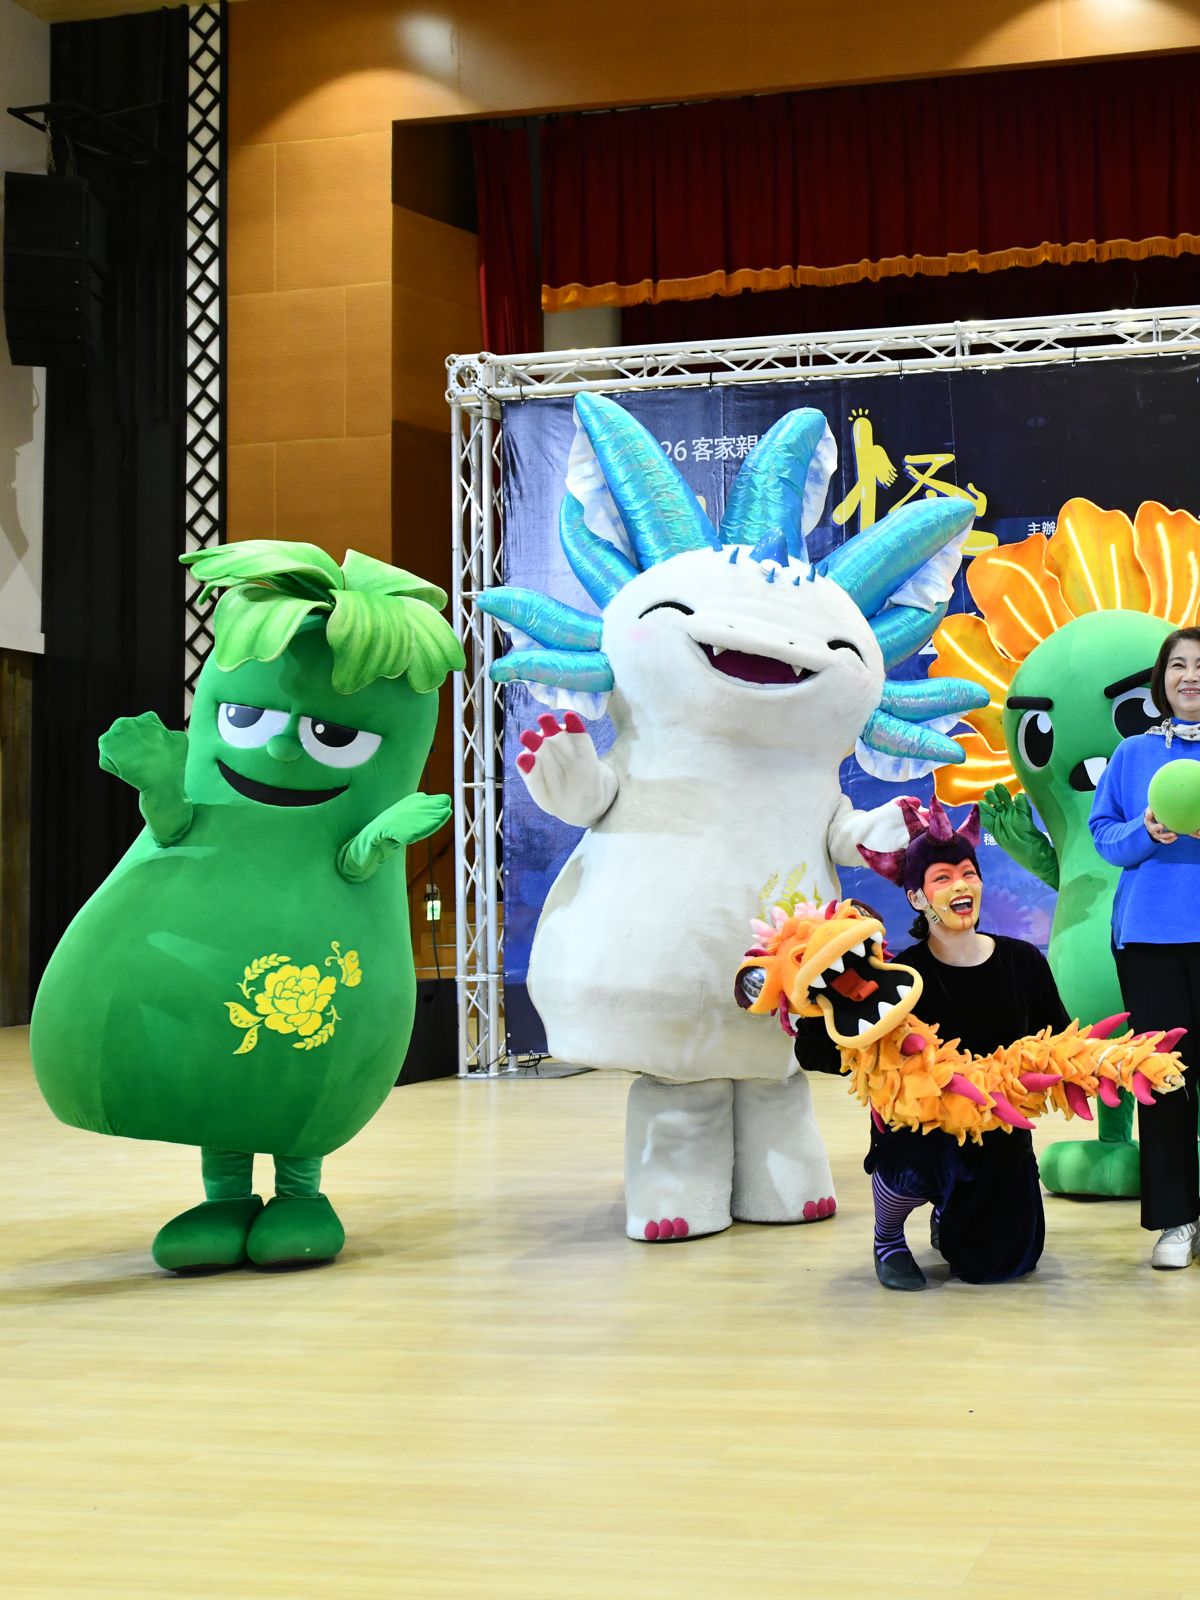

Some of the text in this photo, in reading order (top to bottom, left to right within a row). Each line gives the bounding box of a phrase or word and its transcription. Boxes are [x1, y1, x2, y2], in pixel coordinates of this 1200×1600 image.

[691, 434, 765, 462] 客家親
[1027, 520, 1056, 537] 主辦
